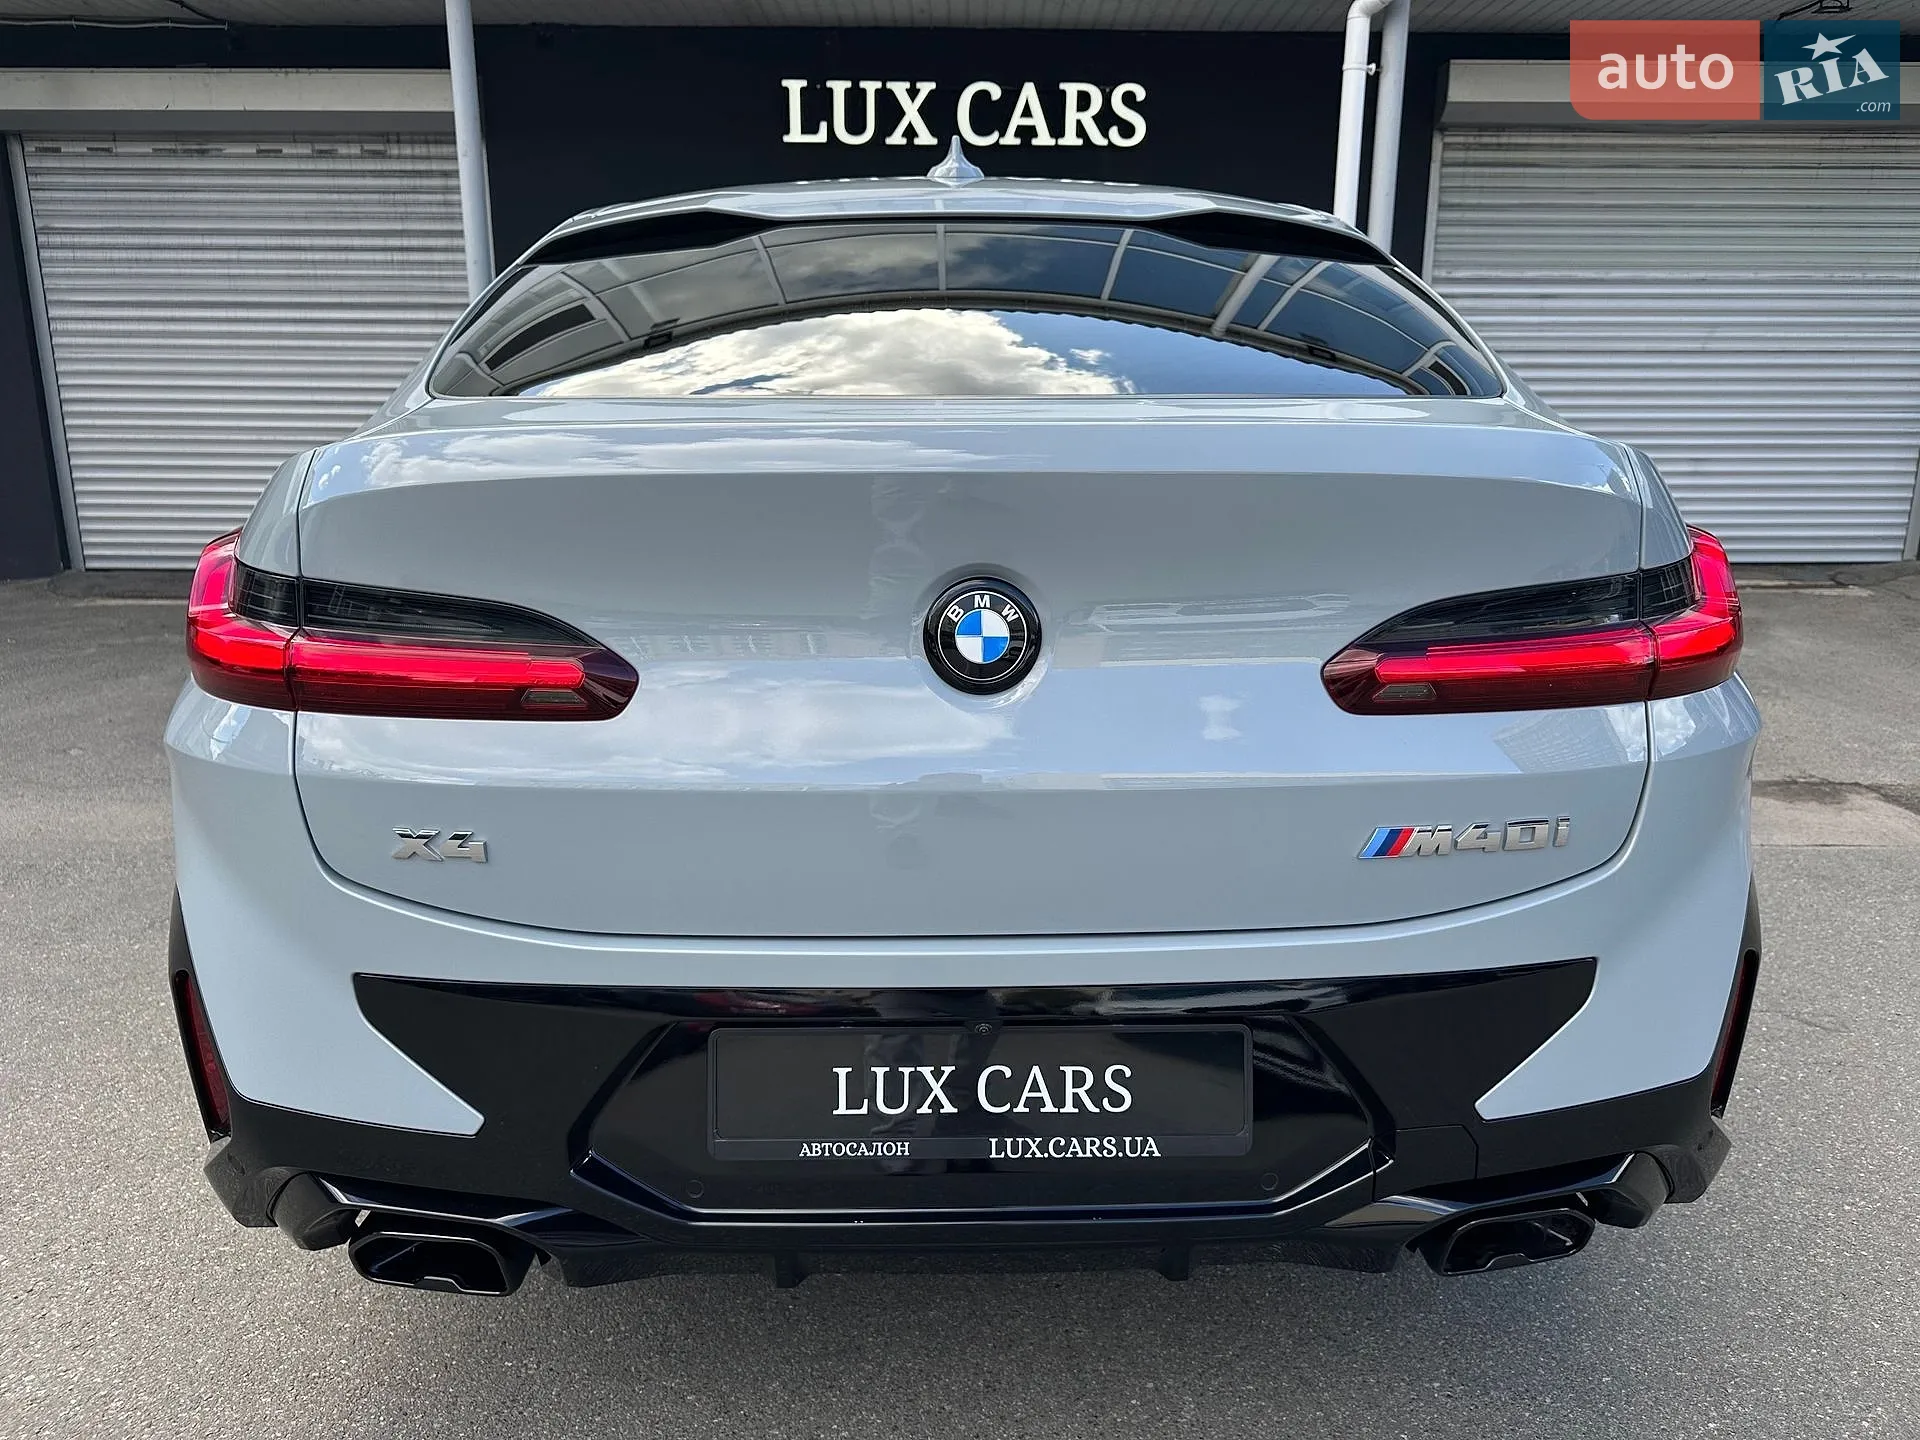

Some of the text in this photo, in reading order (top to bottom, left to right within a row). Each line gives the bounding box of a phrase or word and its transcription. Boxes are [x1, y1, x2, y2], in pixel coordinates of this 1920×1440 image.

[781, 79, 1147, 148] LUX CARS
[946, 594, 1019, 623] BMW
[392, 826, 488, 864] X4
[832, 1064, 1133, 1115] LUX CARS
[799, 1141, 911, 1157] АВТОСАЛОН
[988, 1136, 1161, 1159] LUX.CARS.UA
